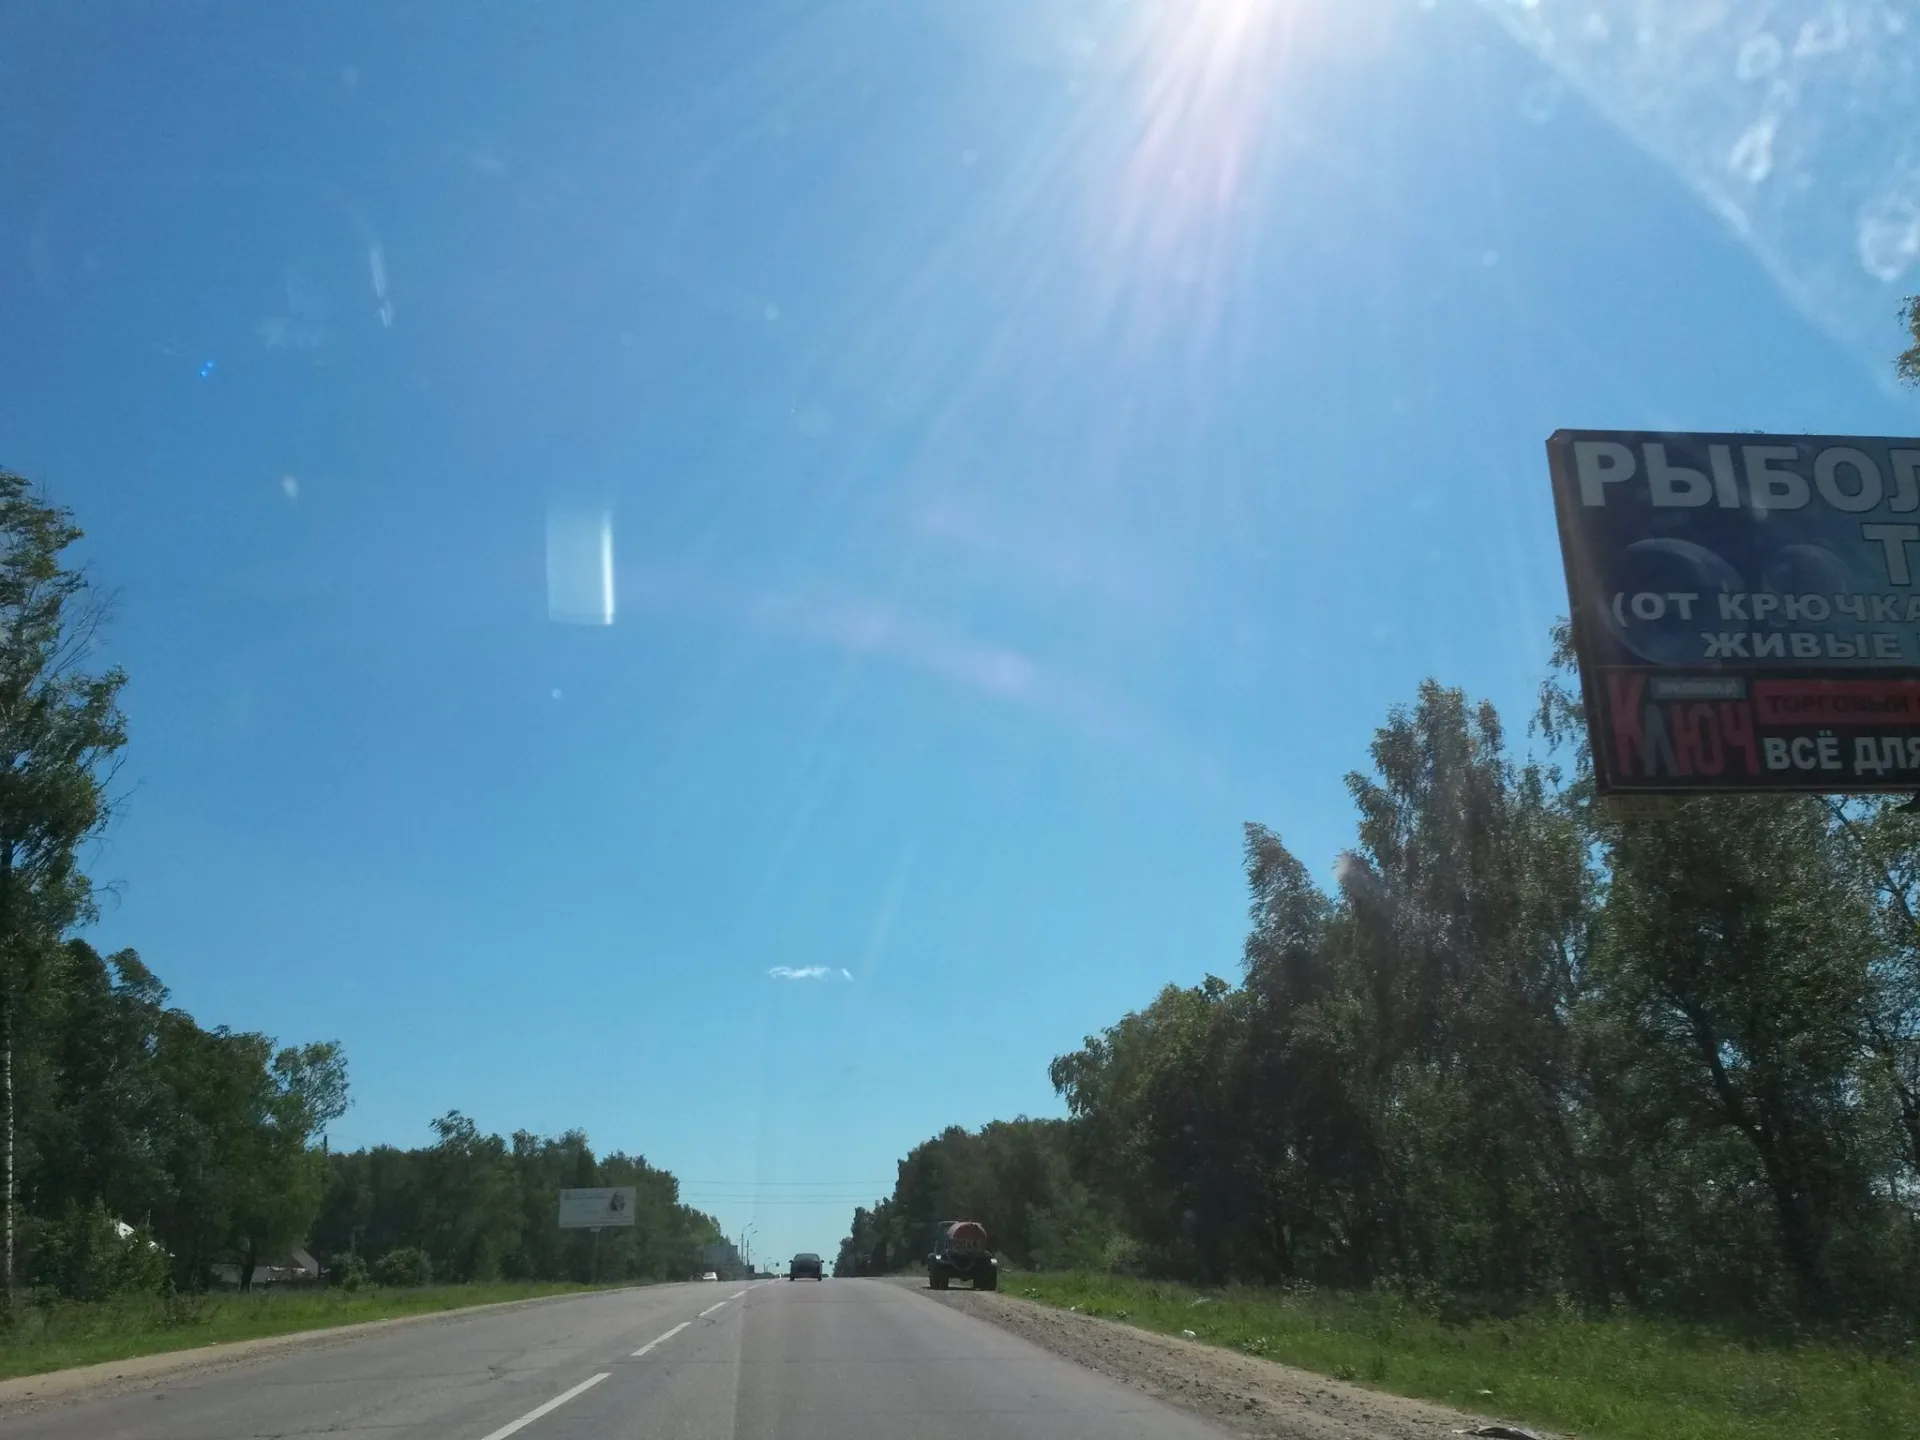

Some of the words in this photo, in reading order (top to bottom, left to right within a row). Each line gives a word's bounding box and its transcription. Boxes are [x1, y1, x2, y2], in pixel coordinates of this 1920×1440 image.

[1612, 592, 1700, 628] (ОТ
[1700, 632, 1903, 659] ЖИВЫЕ
[1607, 672, 1760, 777] КЛЮЧ
[1763, 730, 1843, 771] ВСЁ
[1853, 737, 1920, 776] ДЛЯ
